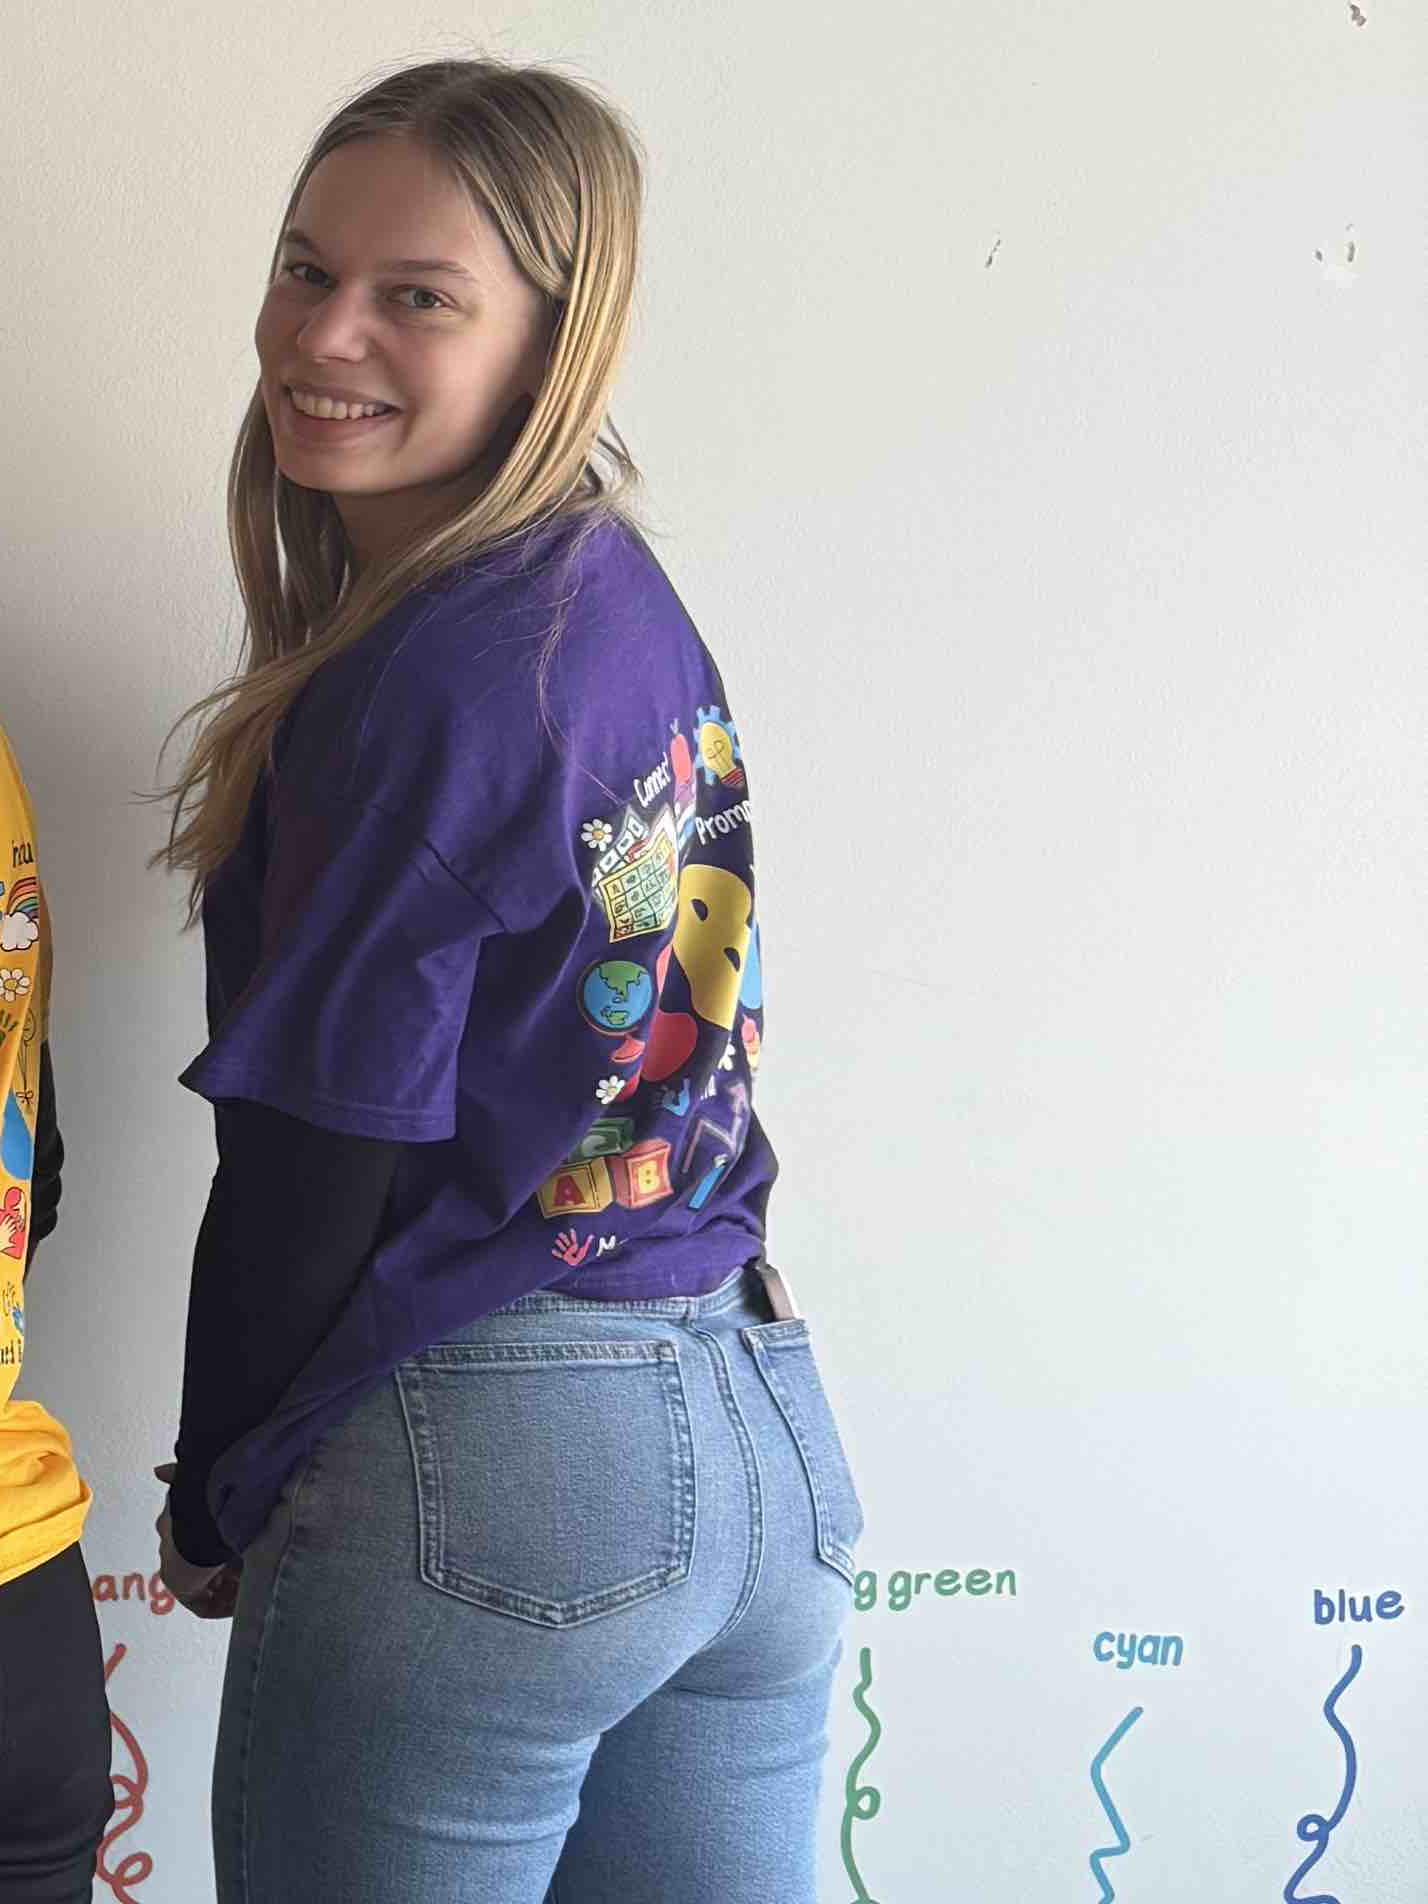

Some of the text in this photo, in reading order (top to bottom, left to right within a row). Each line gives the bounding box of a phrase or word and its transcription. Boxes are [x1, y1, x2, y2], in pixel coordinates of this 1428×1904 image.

[887, 1568, 1017, 1612] green
[1312, 1588, 1405, 1626] blue
[1092, 1630, 1184, 1670] cyan
